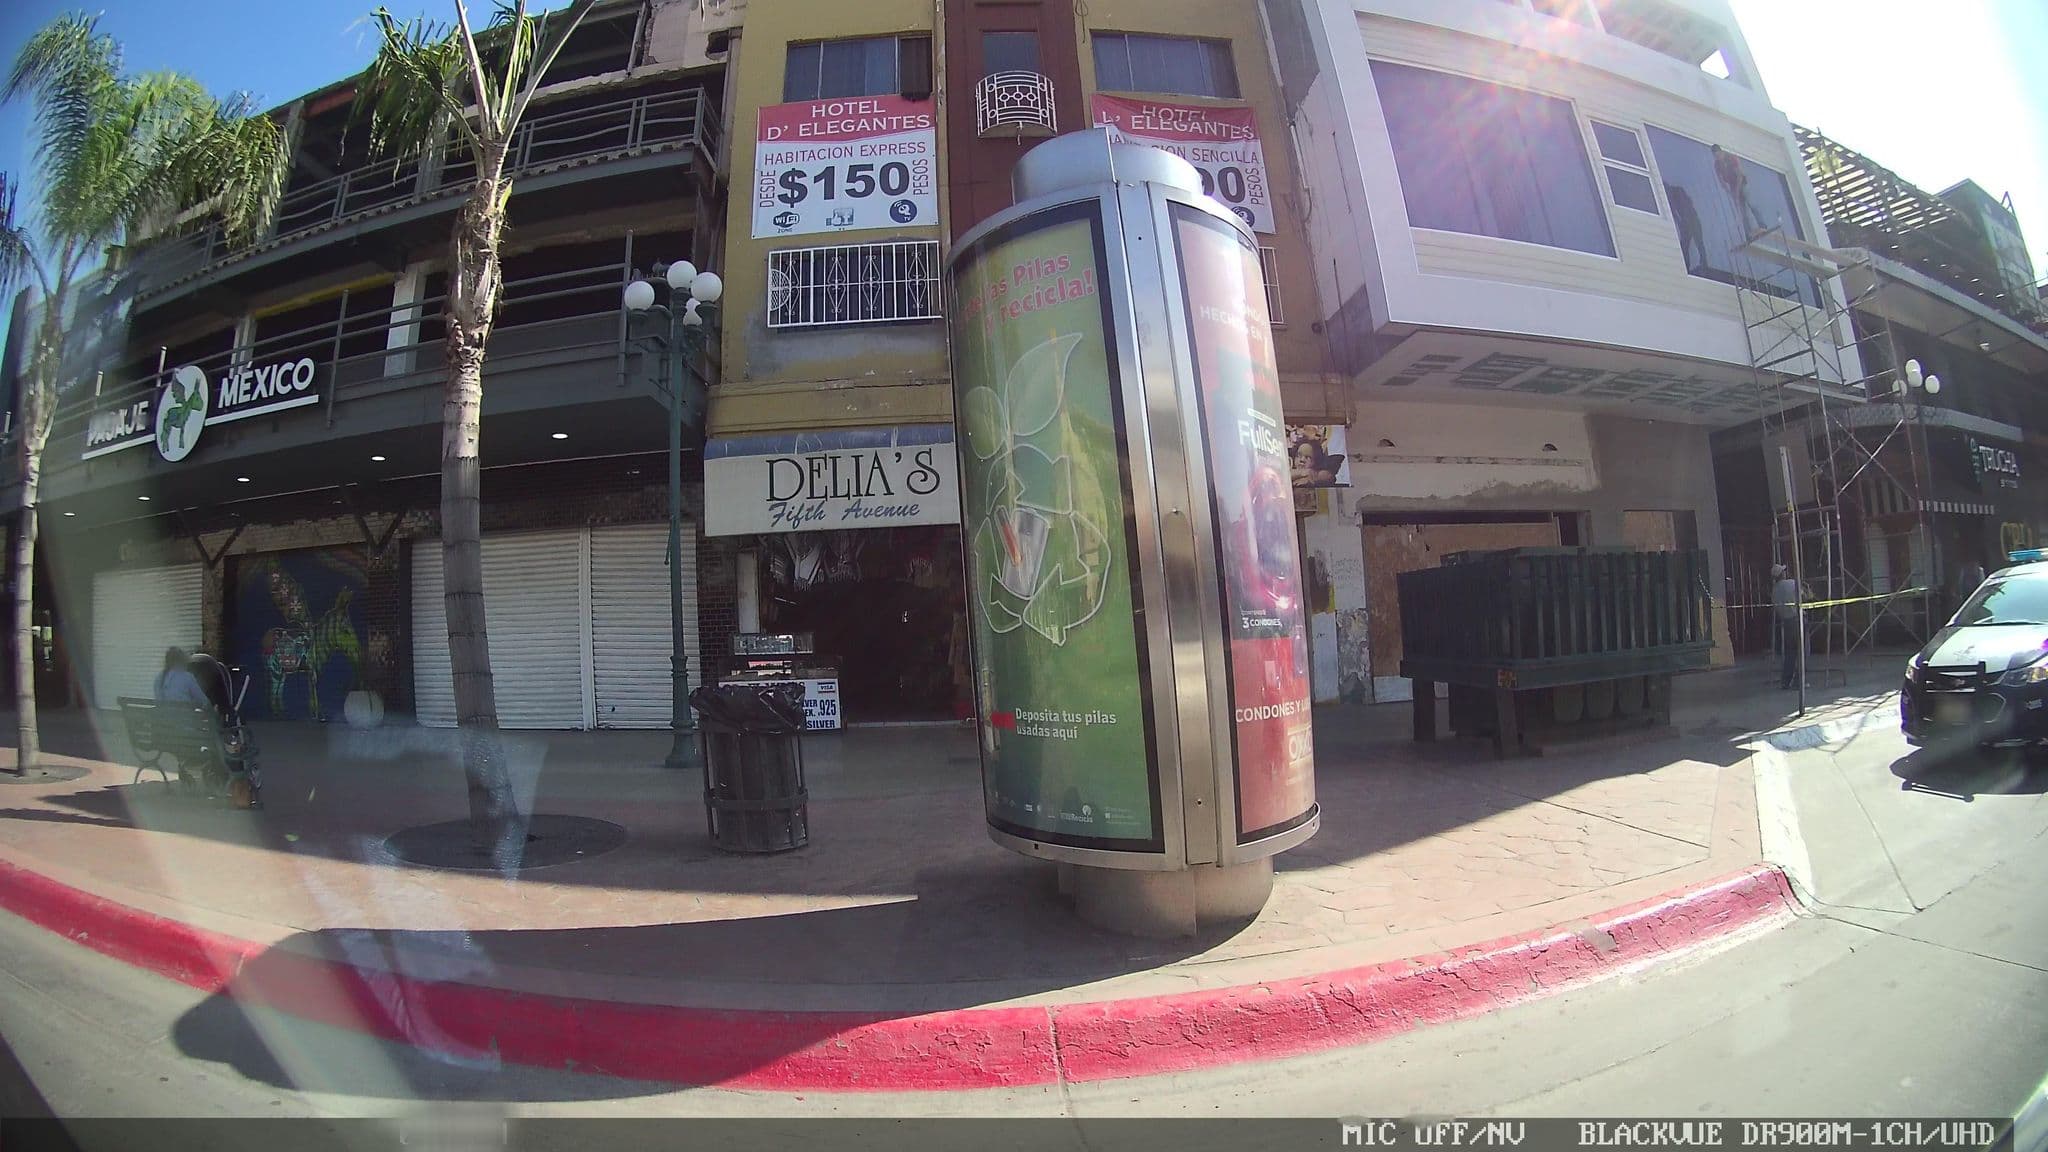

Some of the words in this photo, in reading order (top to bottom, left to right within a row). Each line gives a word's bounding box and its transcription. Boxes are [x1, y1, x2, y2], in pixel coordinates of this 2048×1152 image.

[812, 100, 886, 117] HOTEL
[799, 114, 930, 137] ELEGANTES
[1132, 114, 1255, 140] ELEGANTES
[764, 146, 853, 165] HABITACION
[860, 141, 926, 157] EXPRESS
[1192, 147, 1259, 164] SENCILLA
[760, 169, 776, 208] DESDE
[777, 161, 910, 208] $150
[912, 158, 928, 196] PESOS
[1245, 166, 1264, 206] PESOS
[1013, 254, 1071, 288] Pilas
[1000, 267, 1096, 324] recicla!
[218, 357, 315, 408] MÉXICO
[768, 500, 826, 529] Fifth
[842, 499, 920, 520] Avenue
[1242, 617, 1249, 629] 3
[807, 720, 835, 729] SILVER
[1015, 708, 1060, 723] Deposita
[1063, 710, 1082, 723] tus
[1085, 711, 1117, 725] pilas
[1235, 702, 1295, 723] CONDONES
[1017, 724, 1050, 738] usadas
